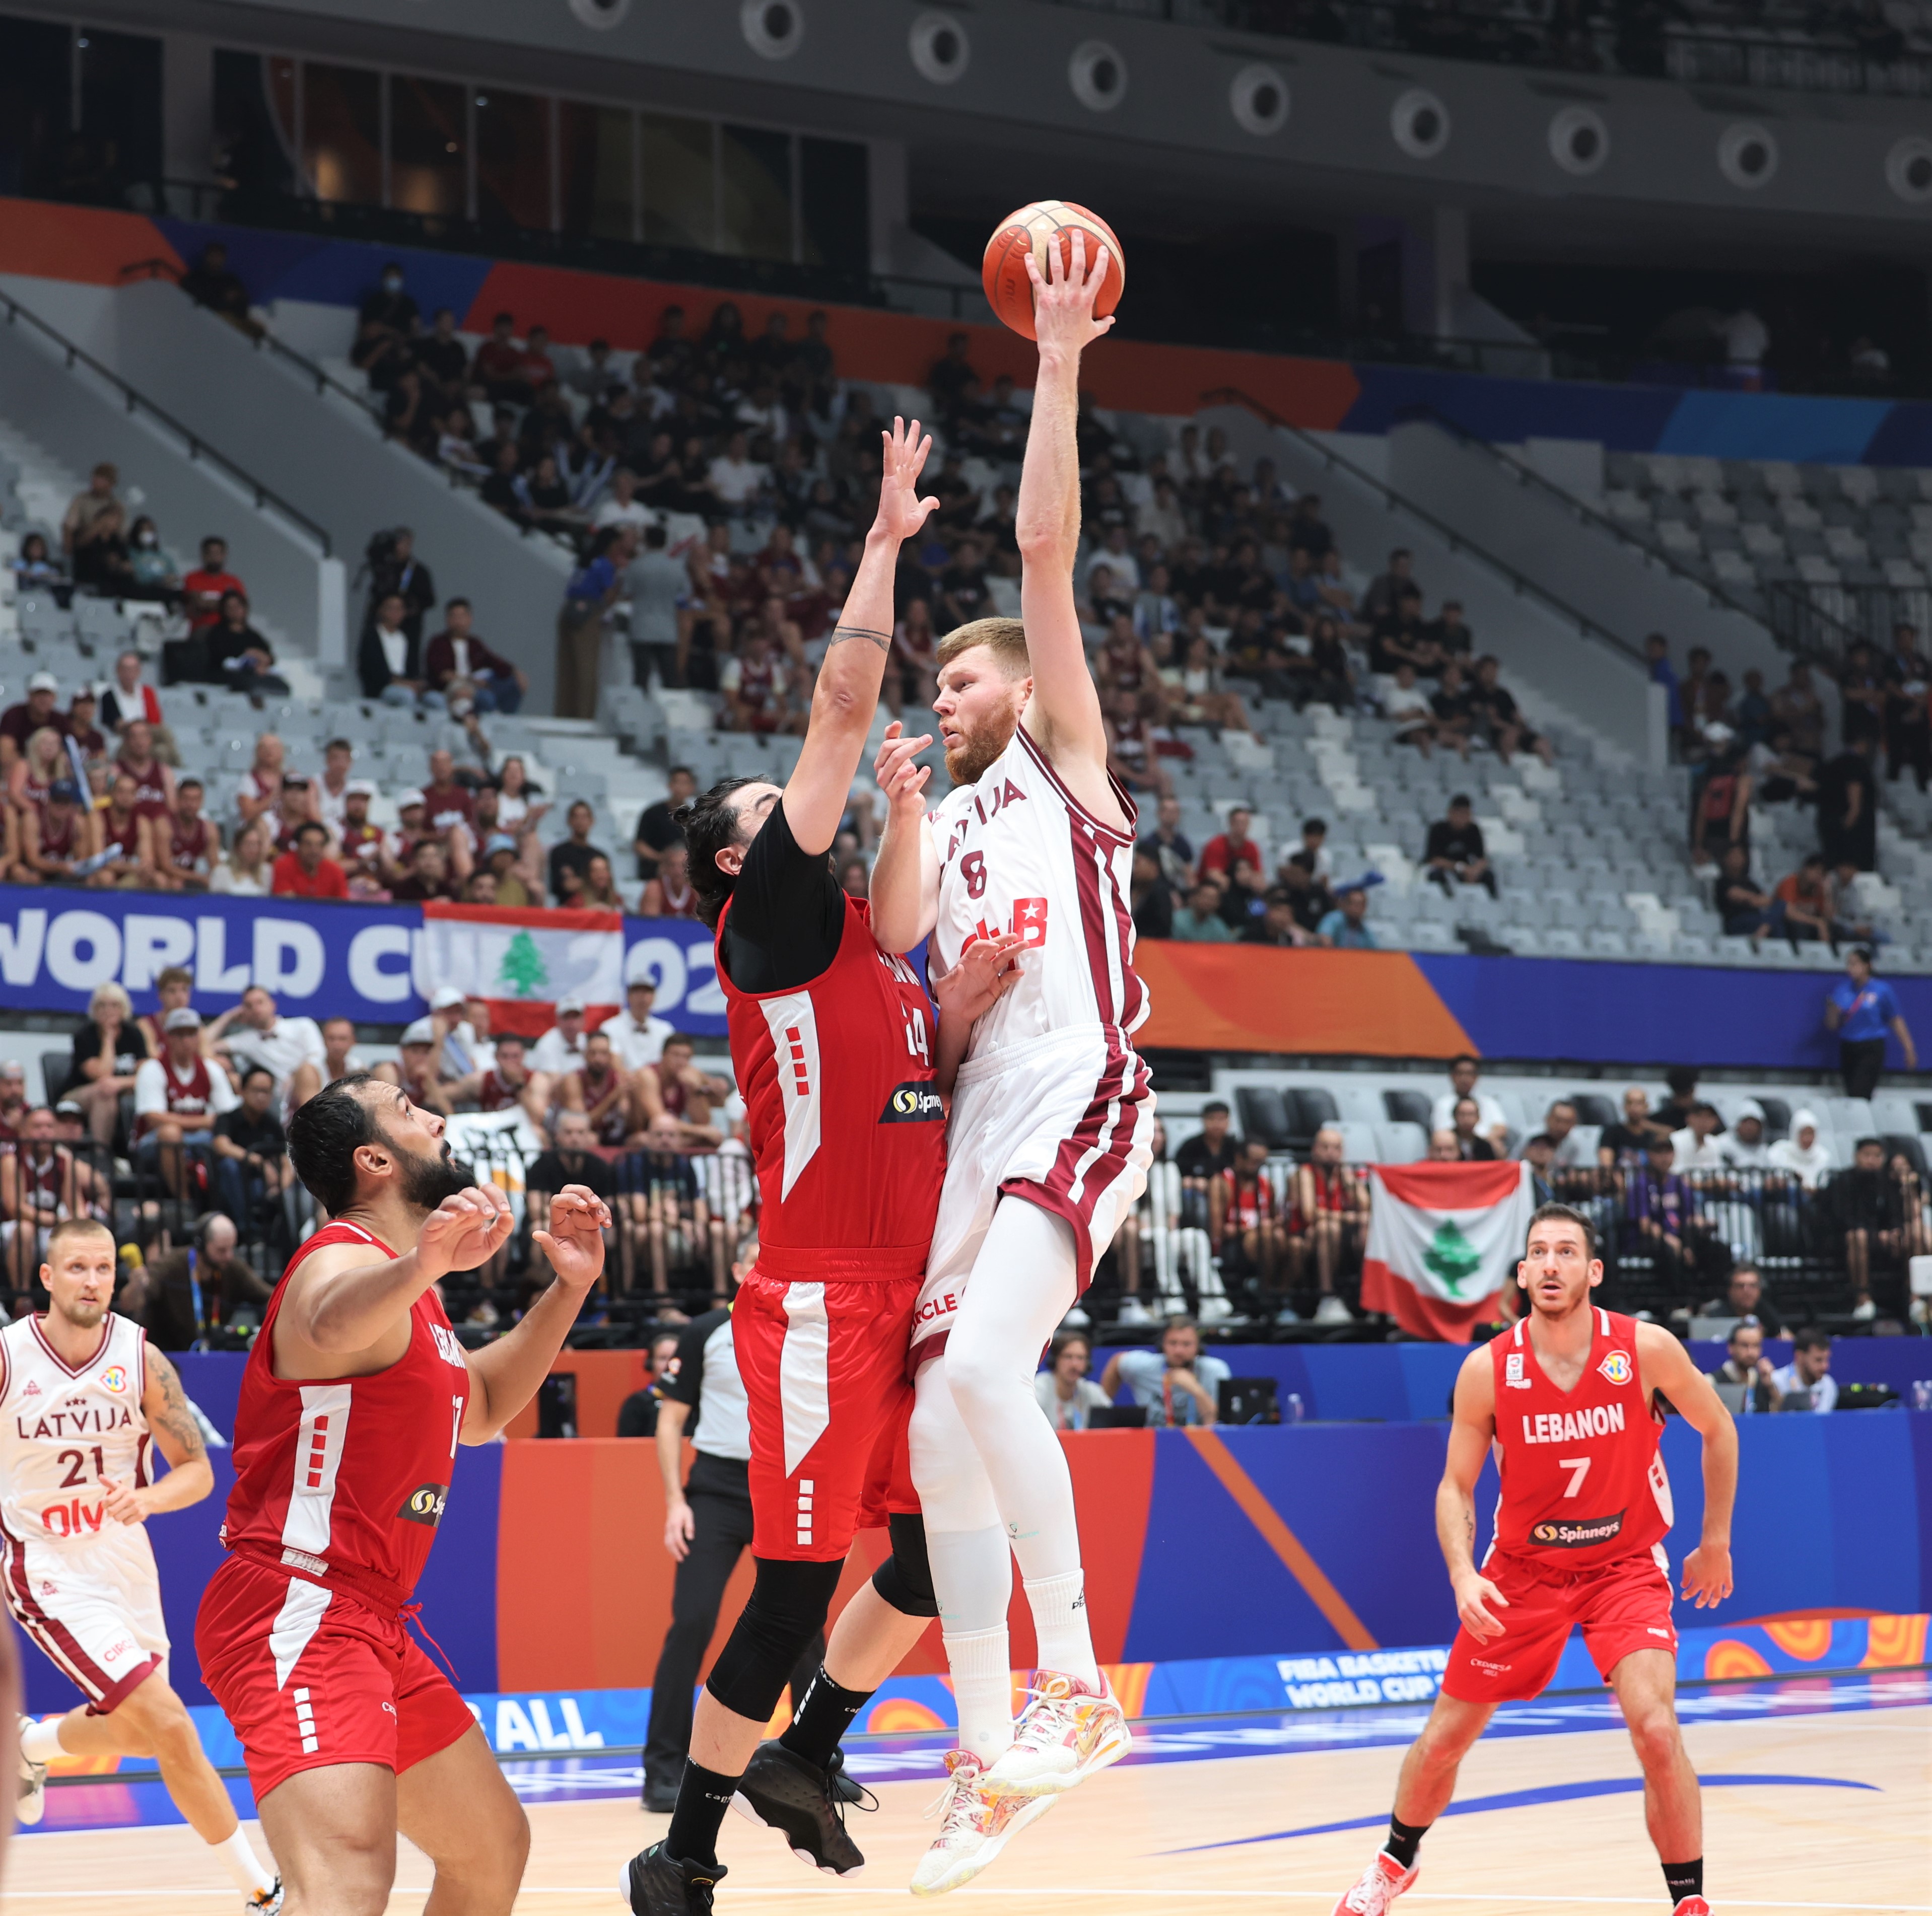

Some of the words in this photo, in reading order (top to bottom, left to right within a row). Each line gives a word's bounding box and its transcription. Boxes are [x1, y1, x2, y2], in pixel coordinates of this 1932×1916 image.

[960, 850, 987, 900] 8
[0, 908, 325, 999] WORLD
[17, 1406, 132, 1439] LATVIJA
[1523, 1403, 1625, 1444] LEBANON
[57, 1445, 104, 1488] 21
[1559, 1457, 1592, 1498] 7
[1559, 1521, 1620, 1543] Spinneys
[1276, 1657, 1340, 1682] FIBA
[1336, 1649, 1452, 1677] BASKETB
[1285, 1679, 1383, 1709] WORLD
[1381, 1674, 1435, 1702] CUP
